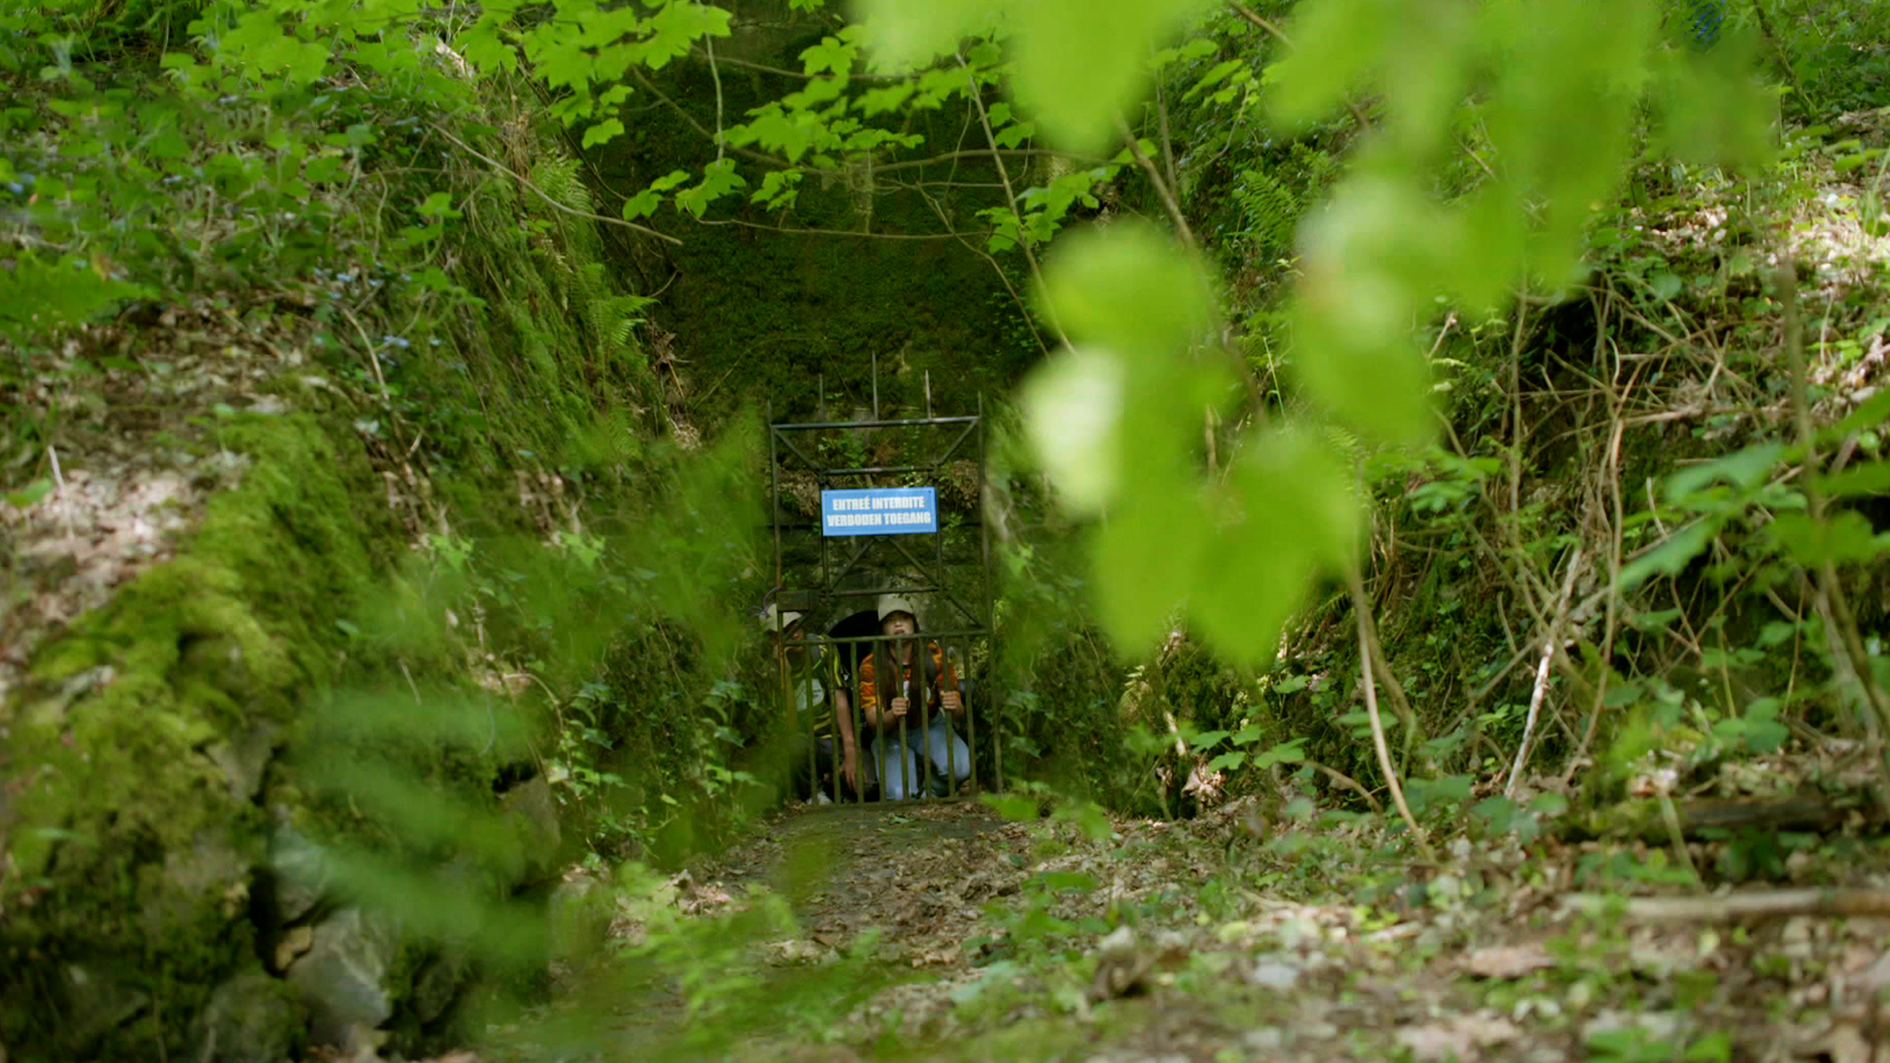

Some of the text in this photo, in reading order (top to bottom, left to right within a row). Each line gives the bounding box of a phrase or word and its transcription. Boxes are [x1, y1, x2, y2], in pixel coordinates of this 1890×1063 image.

[872, 496, 925, 510] INTERDITE
[827, 512, 931, 527] VERBODEN TOEGANG
